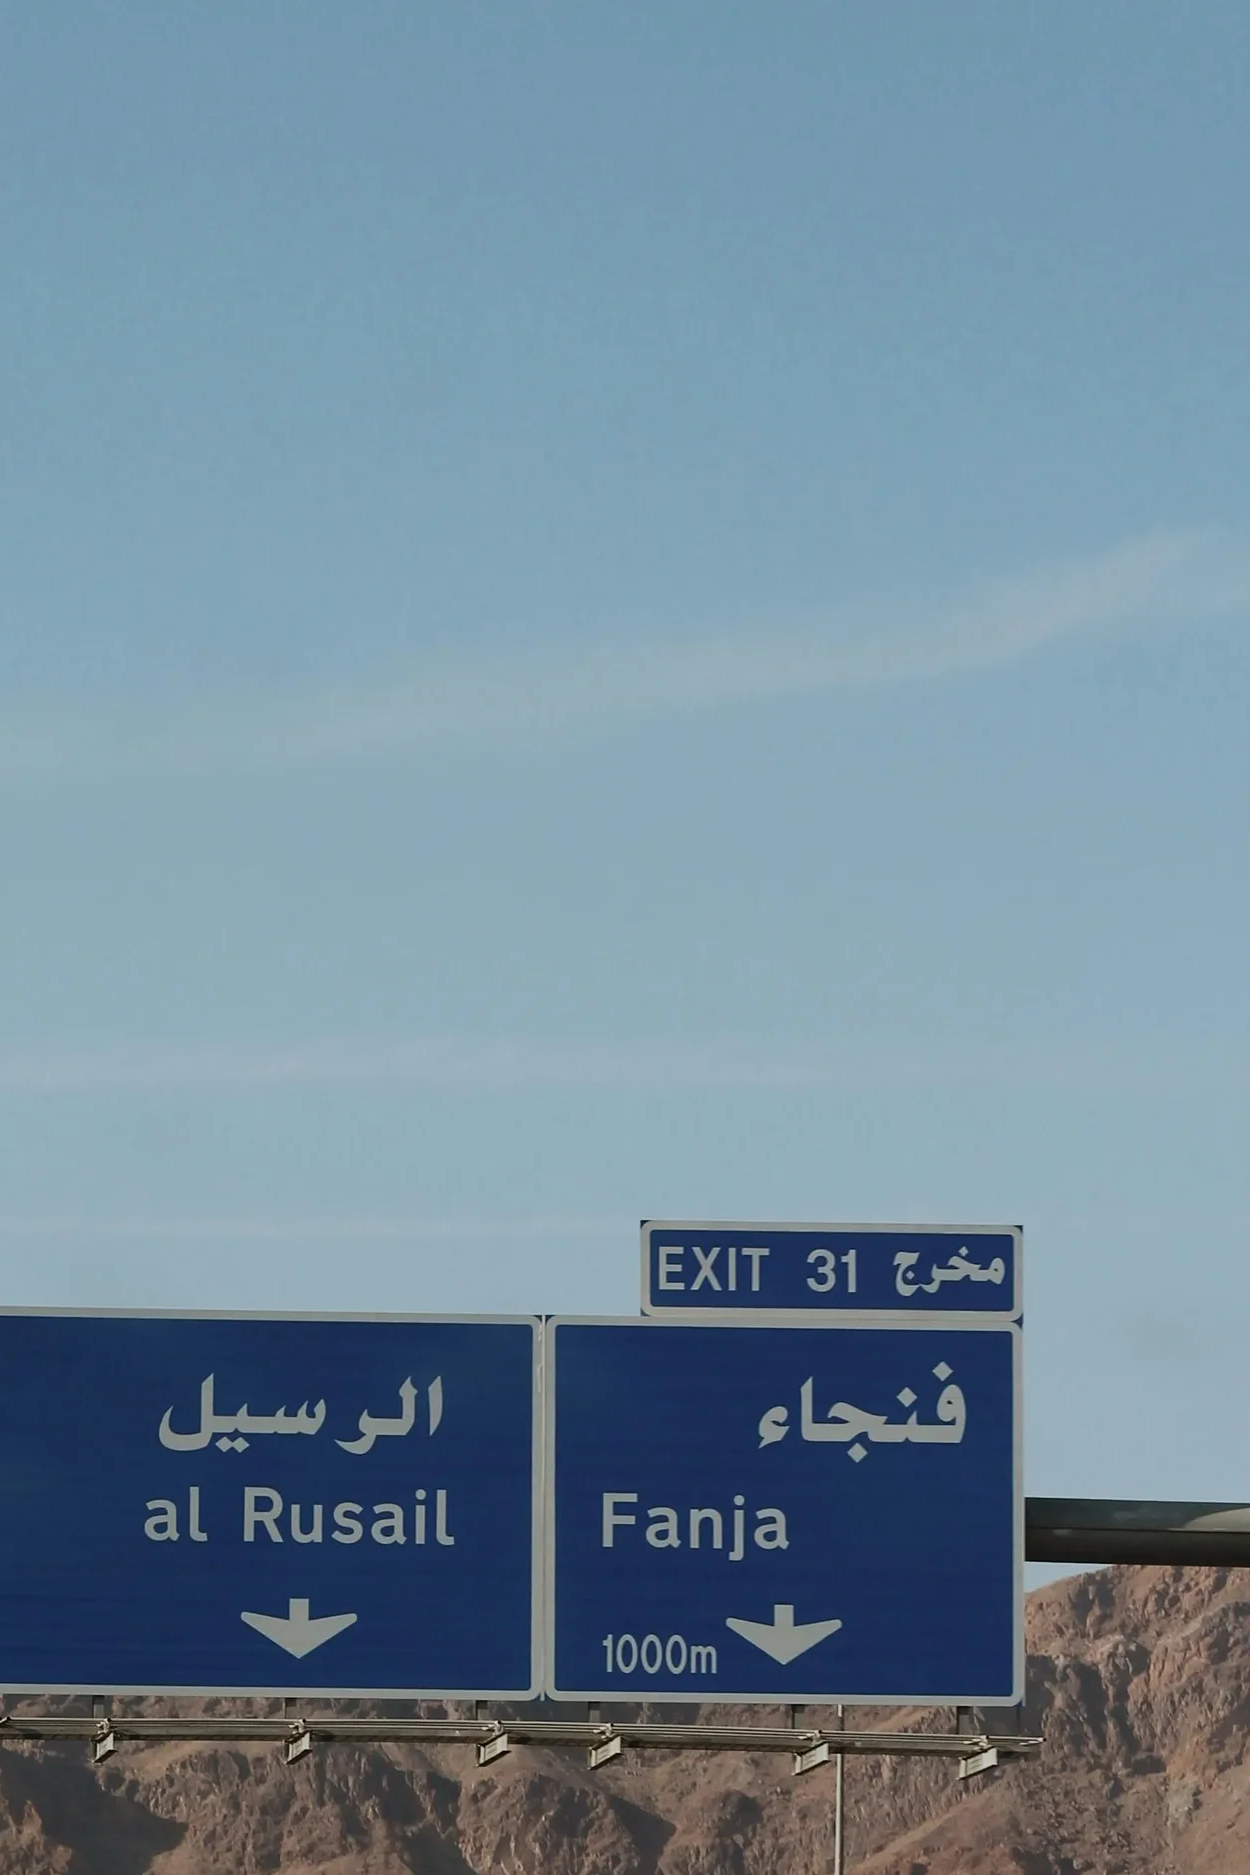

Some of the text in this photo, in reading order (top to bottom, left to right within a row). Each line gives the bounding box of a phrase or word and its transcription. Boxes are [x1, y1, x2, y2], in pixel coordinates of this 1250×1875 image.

[658, 1245, 858, 1293] EXIT 31
[893, 1246, 1006, 1297] مخرج
[158, 1372, 443, 1455] الرسيل
[758, 1361, 967, 1463] فنجاء
[144, 1486, 455, 1546] al Rusail
[602, 1492, 790, 1561] Fanja
[602, 1633, 718, 1675] 1000m
